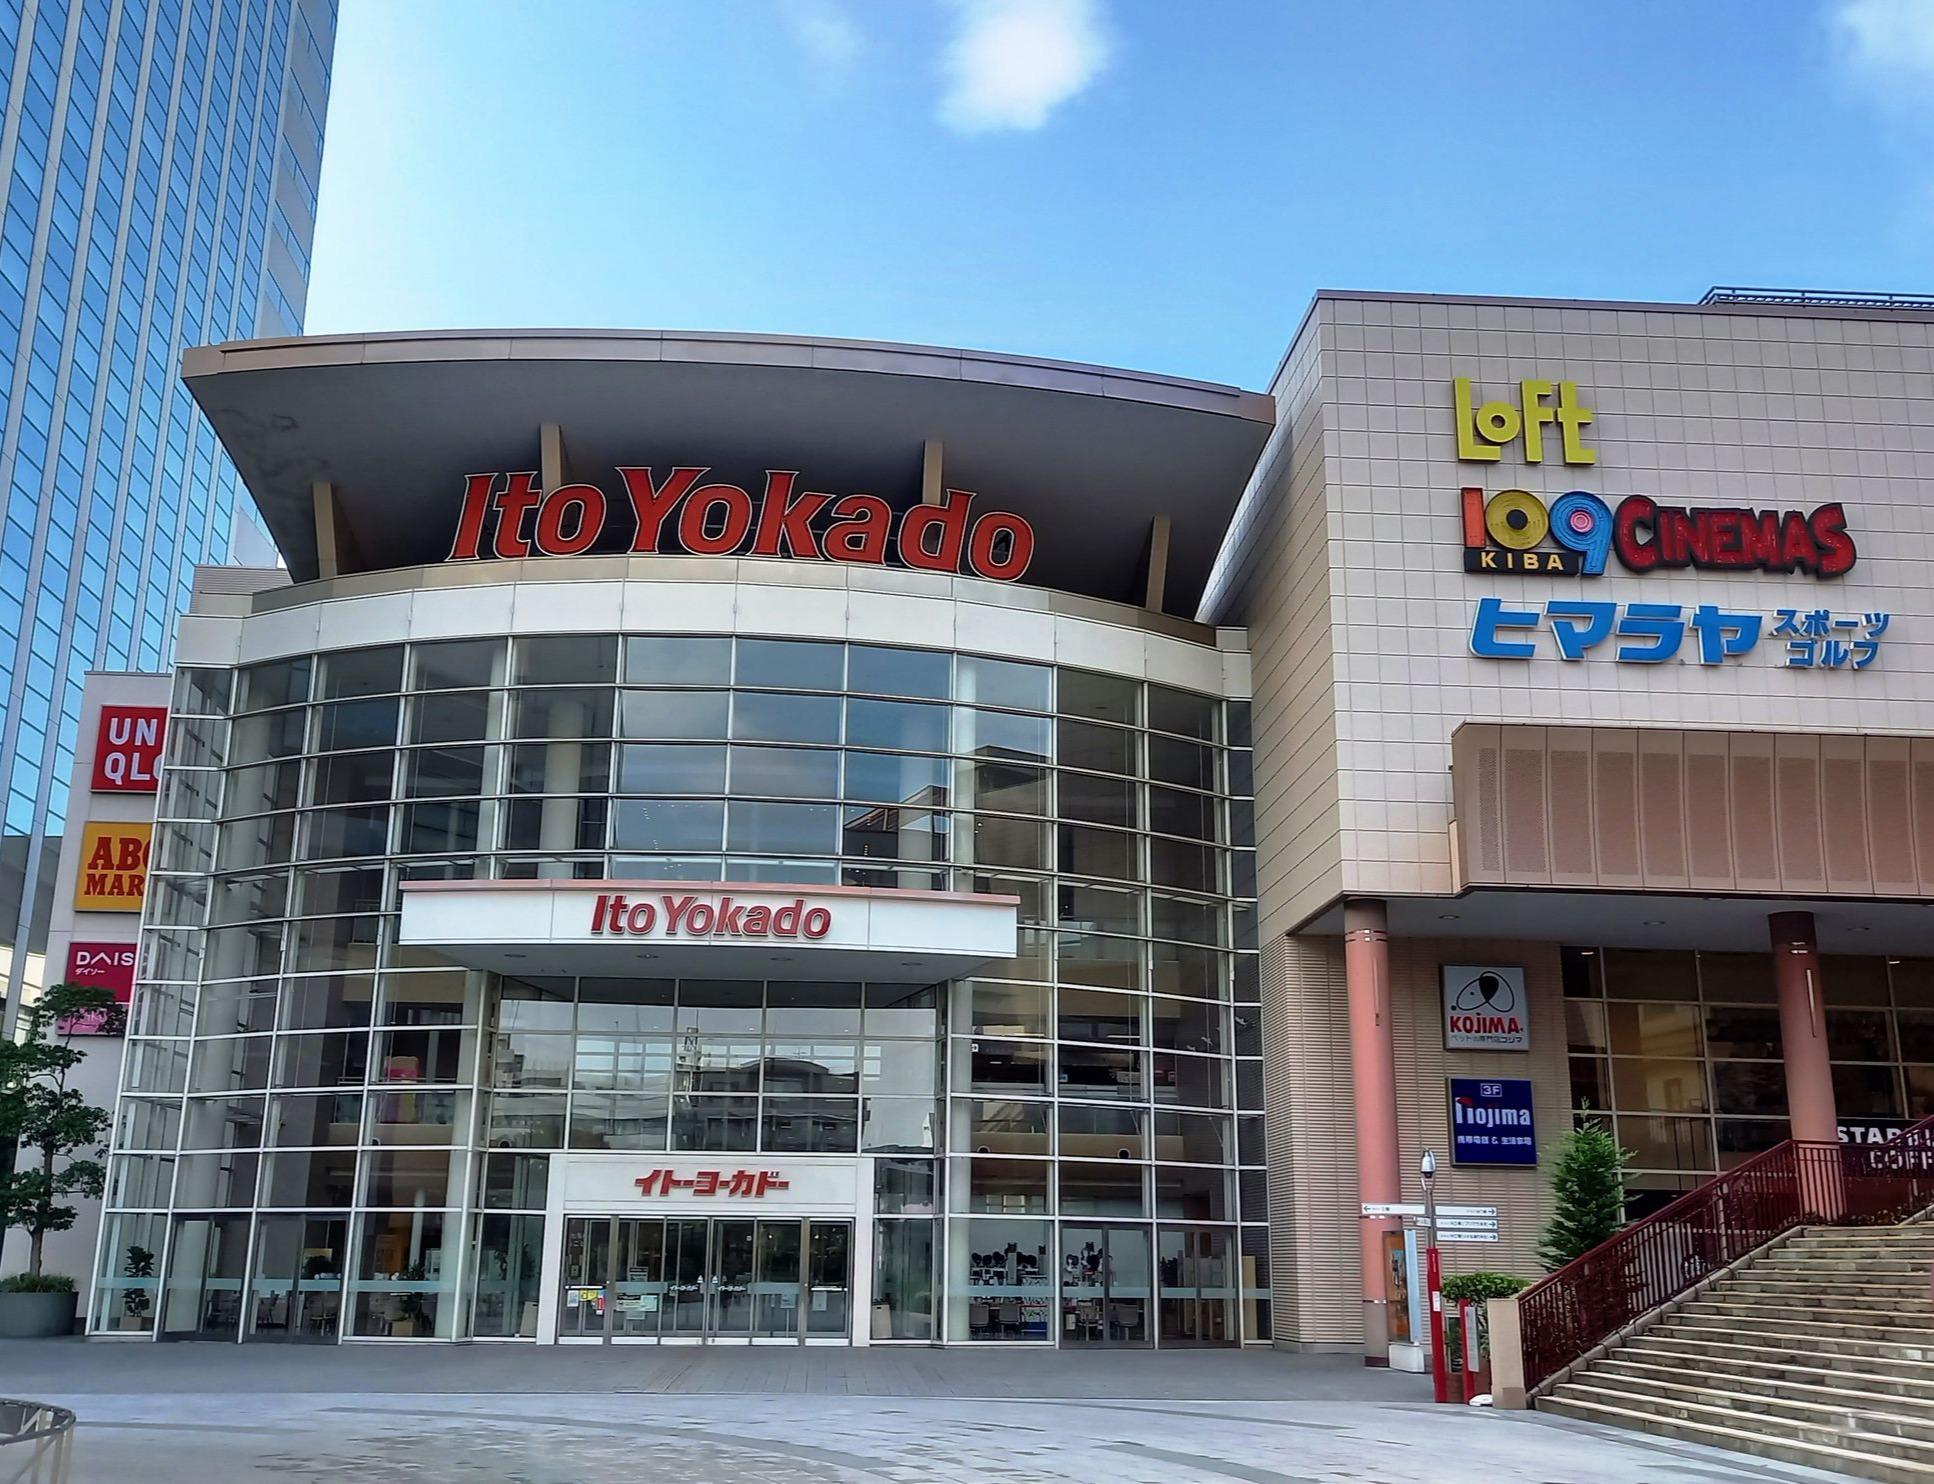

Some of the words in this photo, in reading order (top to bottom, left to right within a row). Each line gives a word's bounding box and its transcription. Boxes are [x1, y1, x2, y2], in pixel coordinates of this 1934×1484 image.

[445, 471, 606, 562] Ito
[616, 466, 1034, 582] Yokado
[1461, 487, 1613, 576] 109
[1613, 494, 1857, 580] CINEMAS
[1481, 552, 1564, 571] KIBA
[1469, 597, 1763, 665] ヒマラヤ
[1769, 609, 1890, 639] スポーツ
[1785, 638, 1879, 670] ゴルフ
[87, 836, 151, 871] AB
[591, 894, 656, 934] Ito
[660, 895, 832, 939] Yokado
[75, 967, 106, 976] ダイソー
[1483, 1085, 1501, 1095] 3F
[635, 1169, 790, 1198] イトーヨーカドー
